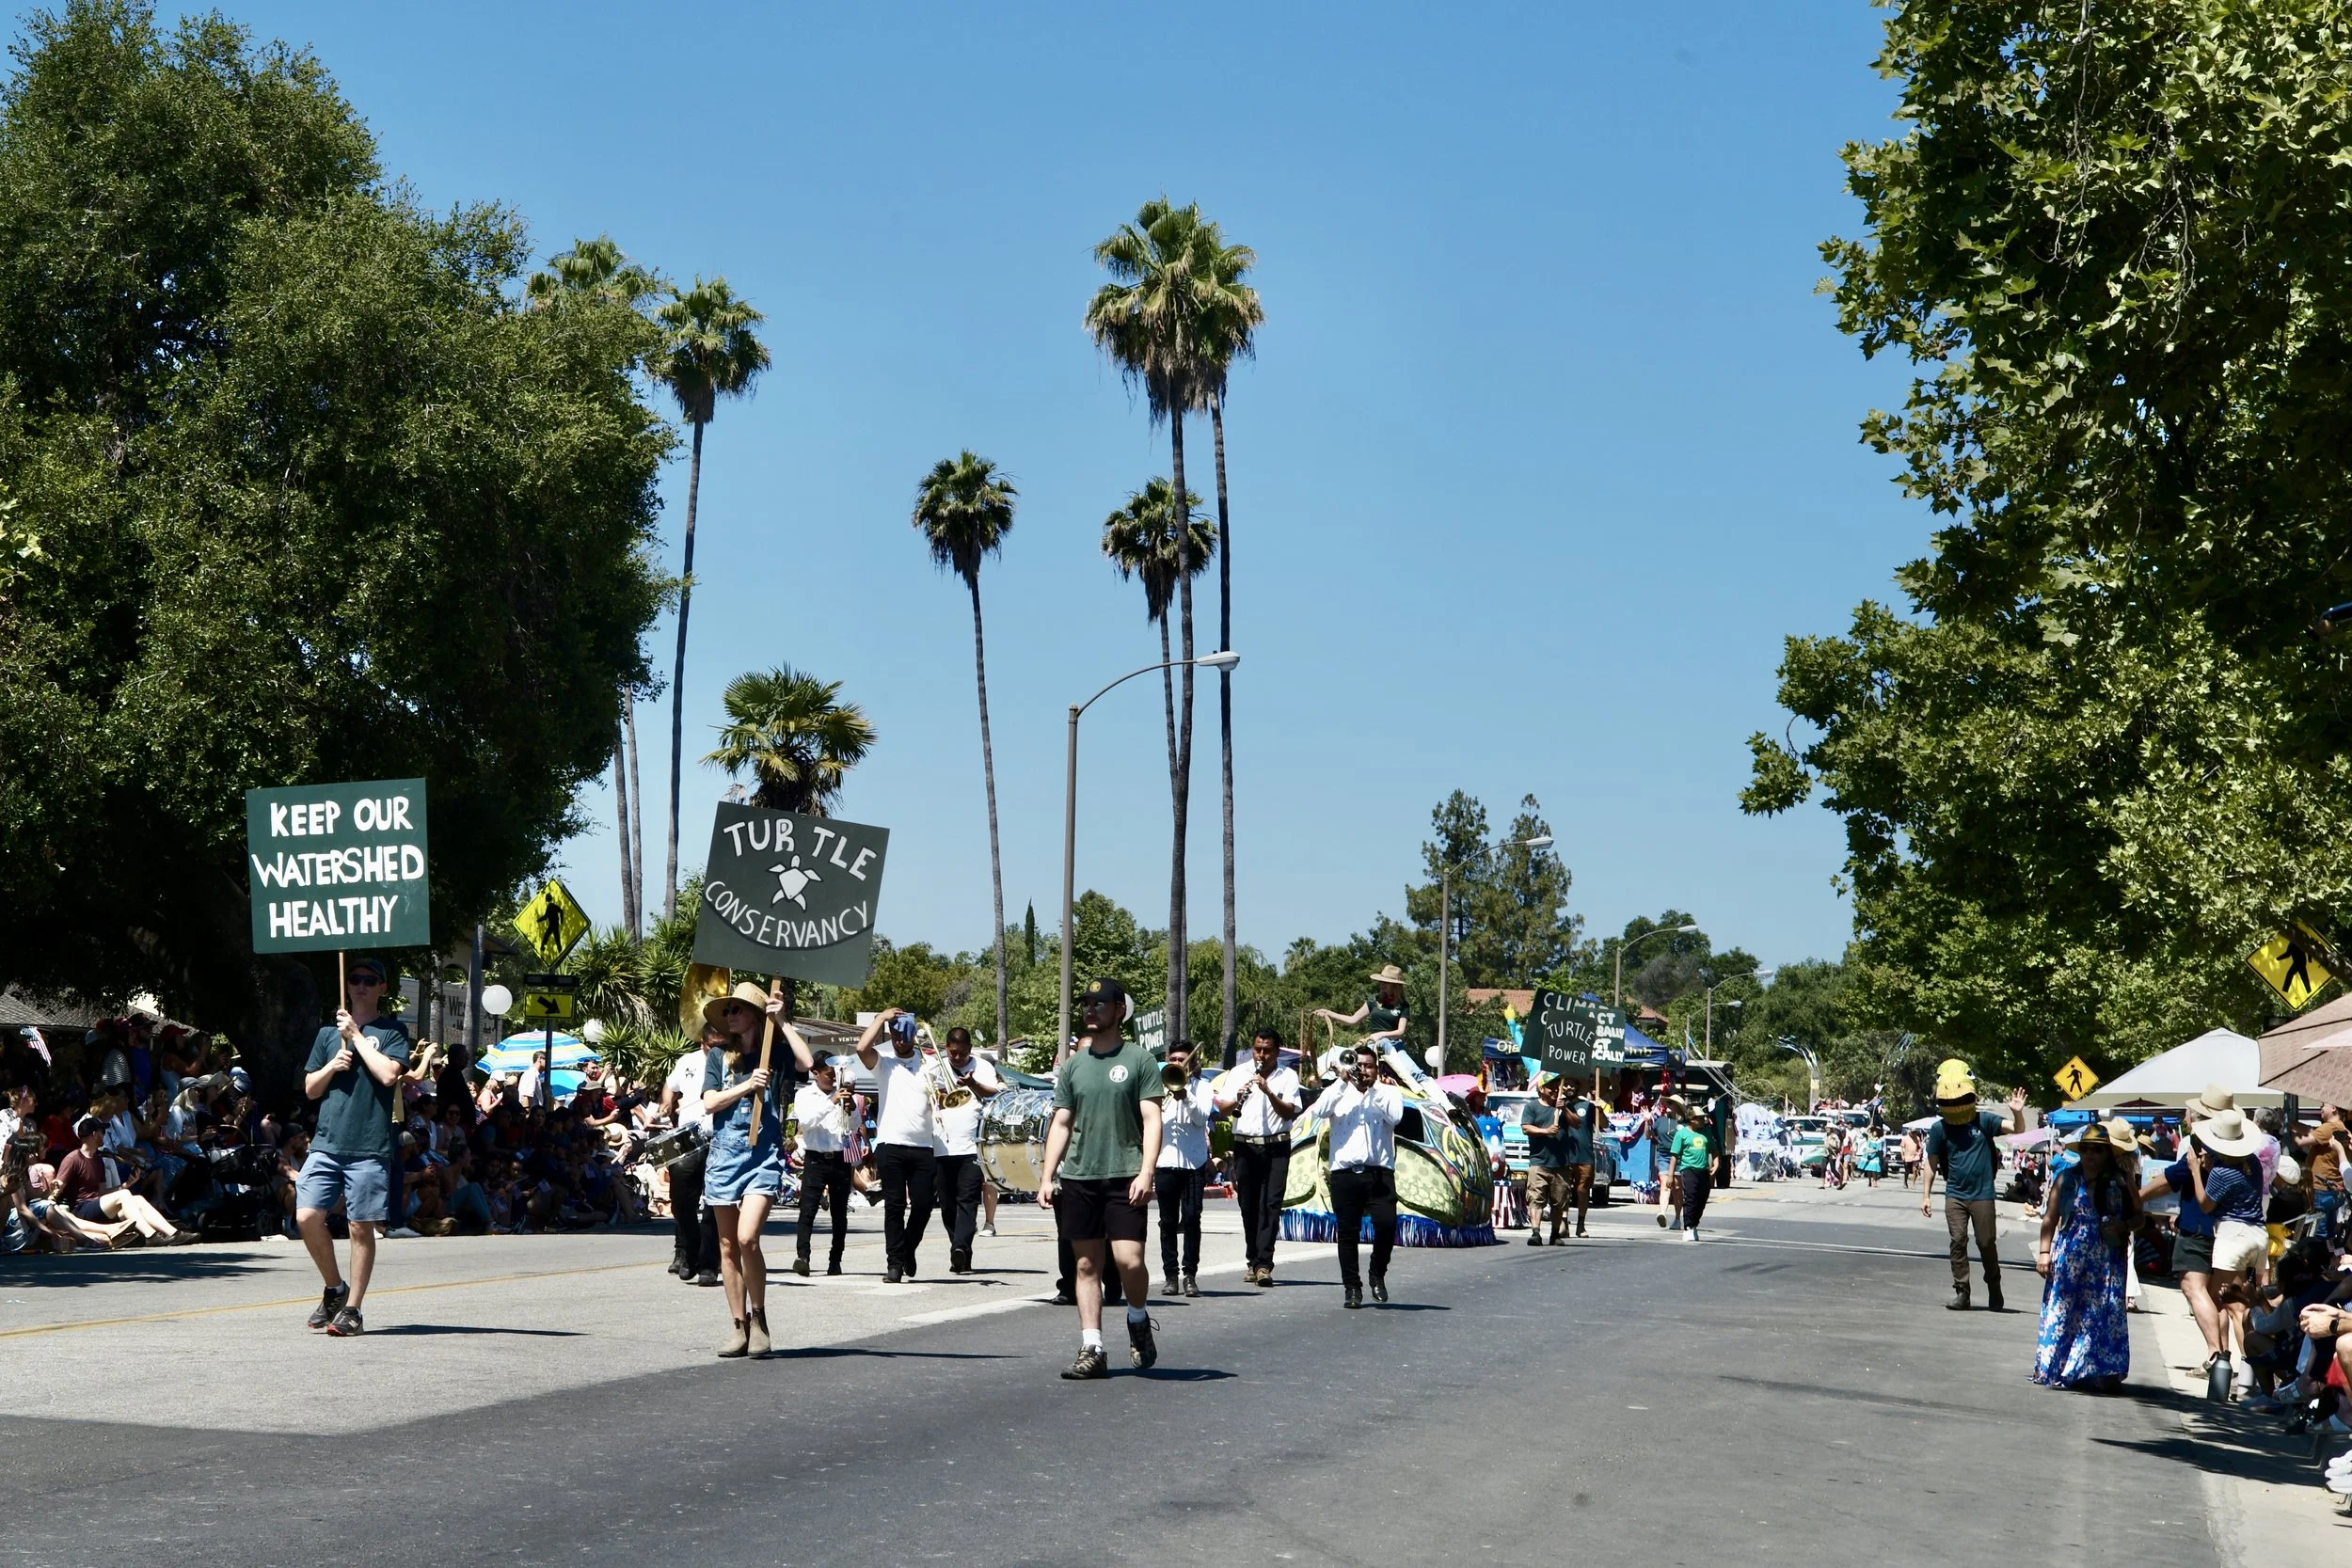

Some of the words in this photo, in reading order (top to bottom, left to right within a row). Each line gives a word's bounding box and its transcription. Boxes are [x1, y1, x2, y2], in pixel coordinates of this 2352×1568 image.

[270, 800, 342, 837] KEEP
[353, 796, 414, 832] OUR
[250, 844, 424, 888] WATERSHED
[723, 818, 877, 881] TURTLE
[268, 895, 399, 939] HEALTHY
[705, 880, 868, 948] CONSERVANCY
[1136, 1009, 1163, 1031] TURTLE
[1547, 1021, 1596, 1047] TURTLE
[1139, 1029, 1164, 1051] POWER
[1496, 1039, 1520, 1055] Oja
[1549, 1044, 1586, 1066] POWER
